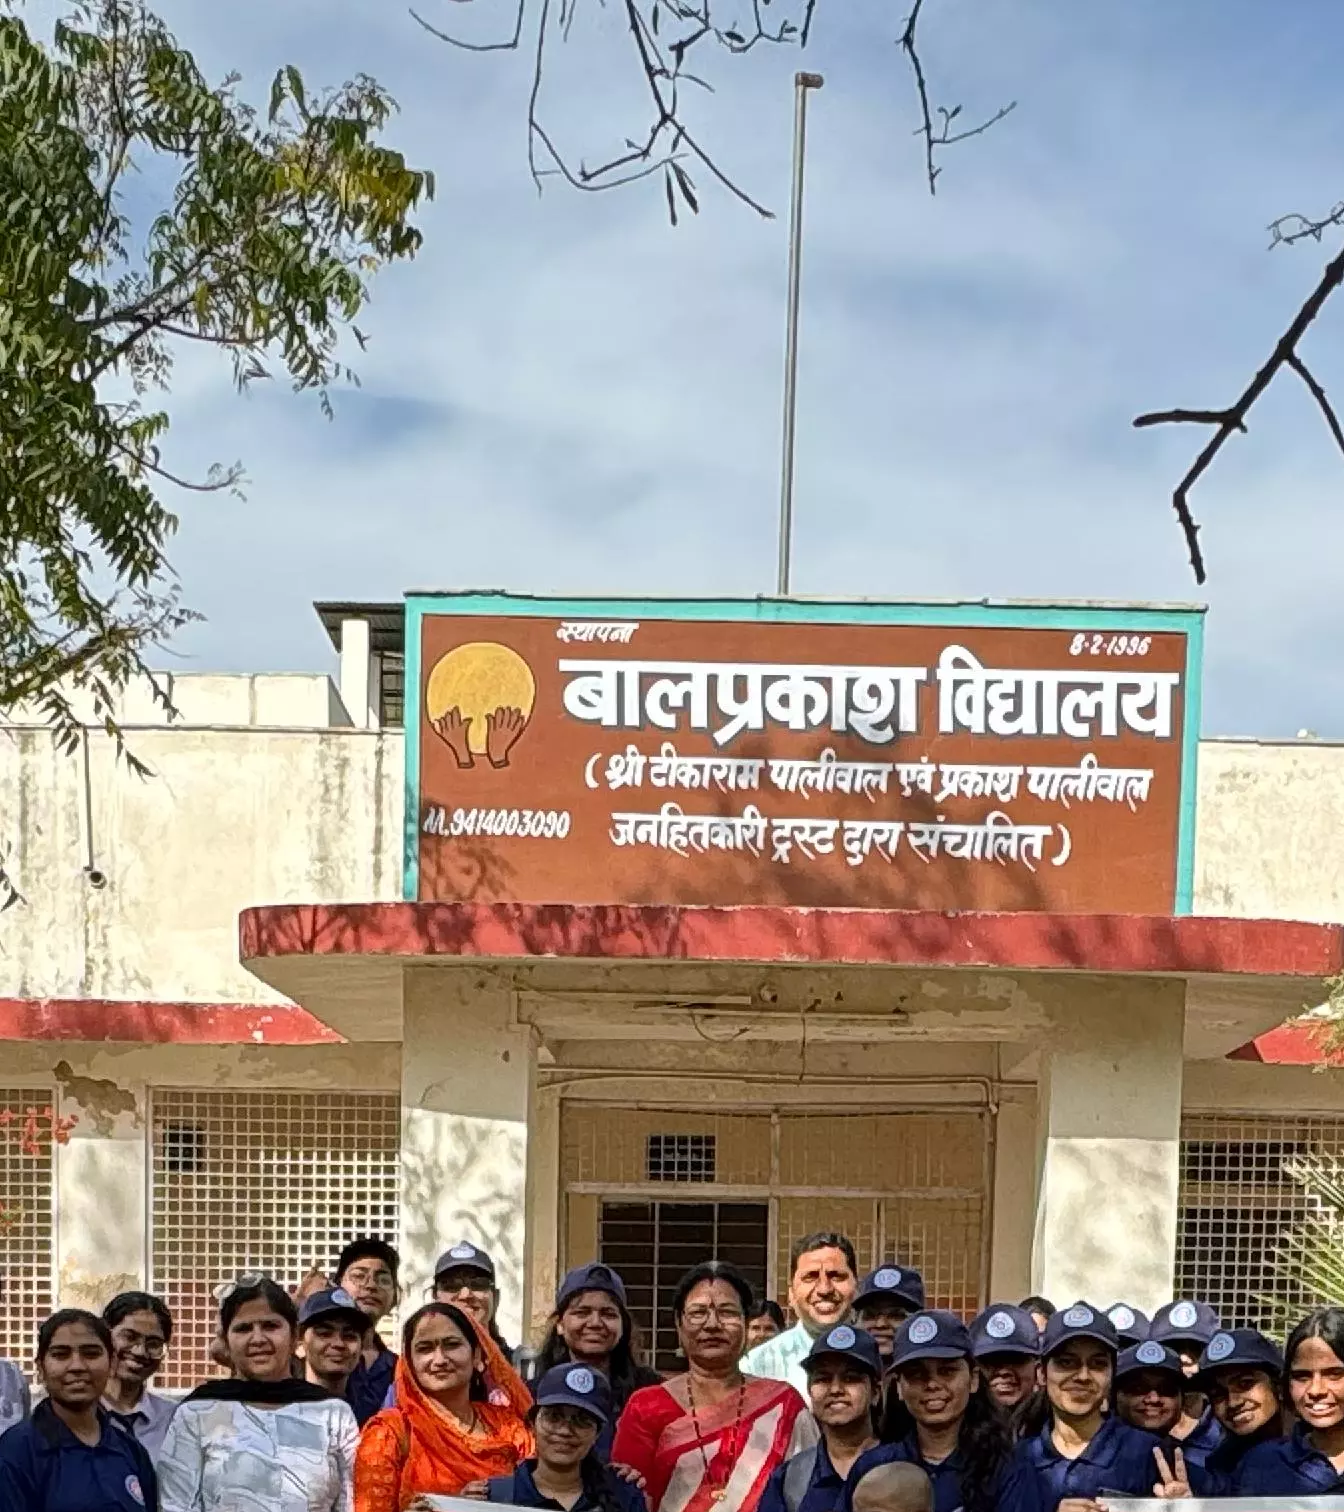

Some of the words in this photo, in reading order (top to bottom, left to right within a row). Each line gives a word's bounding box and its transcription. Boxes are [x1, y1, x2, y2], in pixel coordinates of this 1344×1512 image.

[559, 659, 927, 745] बालप्रकाश
[936, 645, 1180, 738] विद्यालय
[649, 741, 765, 793] टीकाराम
[767, 747, 894, 803] पालीवाल
[895, 756, 936, 796] एवं
[934, 764, 1024, 803] प्रकाश
[1026, 753, 1154, 813] पालीवाल
[609, 802, 767, 858] जनहितकारी
[771, 818, 840, 864] ट्रस्ट
[842, 820, 905, 866] द्वारा
